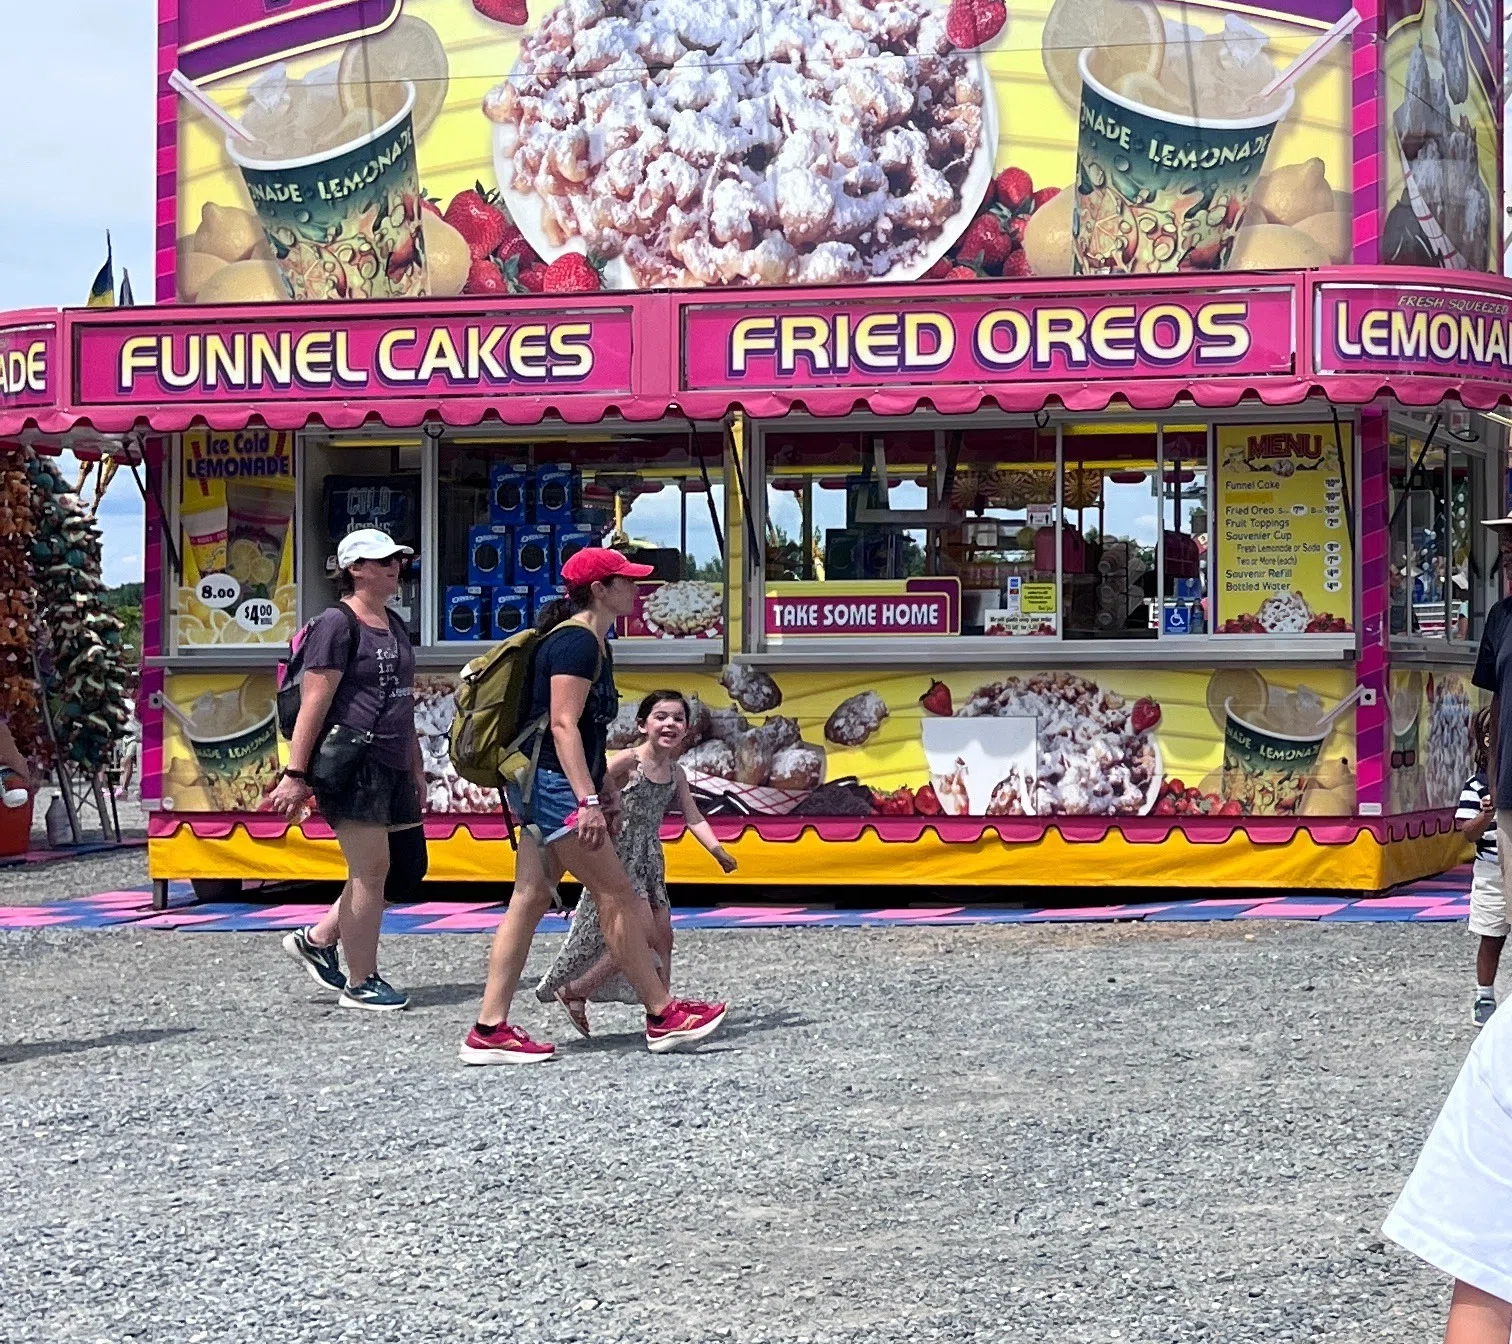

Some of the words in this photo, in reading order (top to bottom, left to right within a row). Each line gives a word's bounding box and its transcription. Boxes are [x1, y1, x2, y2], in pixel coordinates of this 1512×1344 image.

[1148, 133, 1271, 169] LEMONADE
[317, 125, 413, 201] LEMONADE
[1397, 295, 1445, 309] FRESH
[1448, 298, 1510, 316] SQUEEZED
[731, 312, 954, 373] FRIED
[977, 304, 1250, 365] OREOS
[118, 329, 369, 389] FUNNEL
[378, 324, 594, 381] CAKES
[206, 433, 230, 455] Ice
[233, 432, 269, 455] Cold
[1247, 433, 1323, 459] MENU
[185, 456, 289, 479] LEMONADE
[1225, 480, 1255, 490] Funnel
[1257, 480, 1280, 490] Cake
[1225, 505, 1249, 515] Fried
[1251, 505, 1275, 515] Oreo
[1225, 519, 1247, 528] Fruit
[1250, 518, 1290, 529] Toppings
[1273, 531, 1292, 542] Cup
[1237, 544, 1256, 552] Fresh
[1258, 544, 1292, 553] Lemonade
[1302, 543, 1321, 553] Soda
[1268, 568, 1293, 578] Refill
[201, 585, 235, 600] 8.00
[1226, 582, 1260, 592] Bottled
[1262, 582, 1291, 591] Water
[773, 604, 818, 626] TAKE
[823, 604, 877, 626] SOME
[882, 603, 939, 626] HOME
